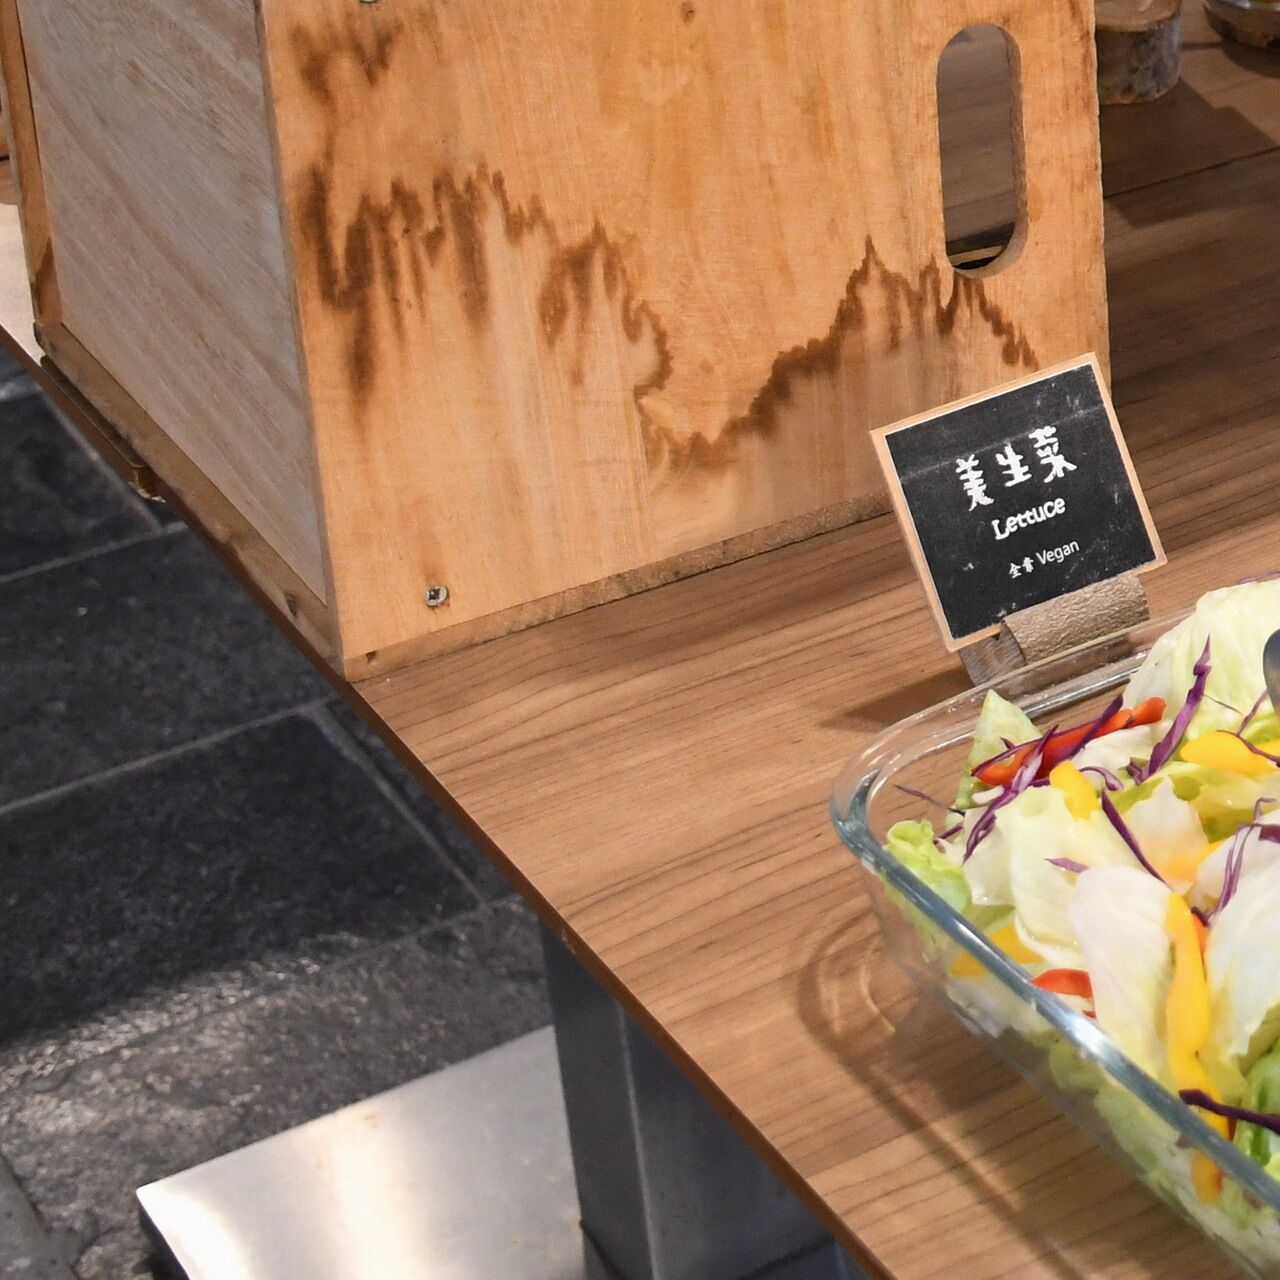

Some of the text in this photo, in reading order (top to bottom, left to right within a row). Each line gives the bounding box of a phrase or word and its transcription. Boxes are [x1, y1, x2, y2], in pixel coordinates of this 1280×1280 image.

[955, 426, 1077, 512] 美生菜
[991, 497, 1066, 540] Lettuce
[1035, 541, 1080, 565] Vegan
